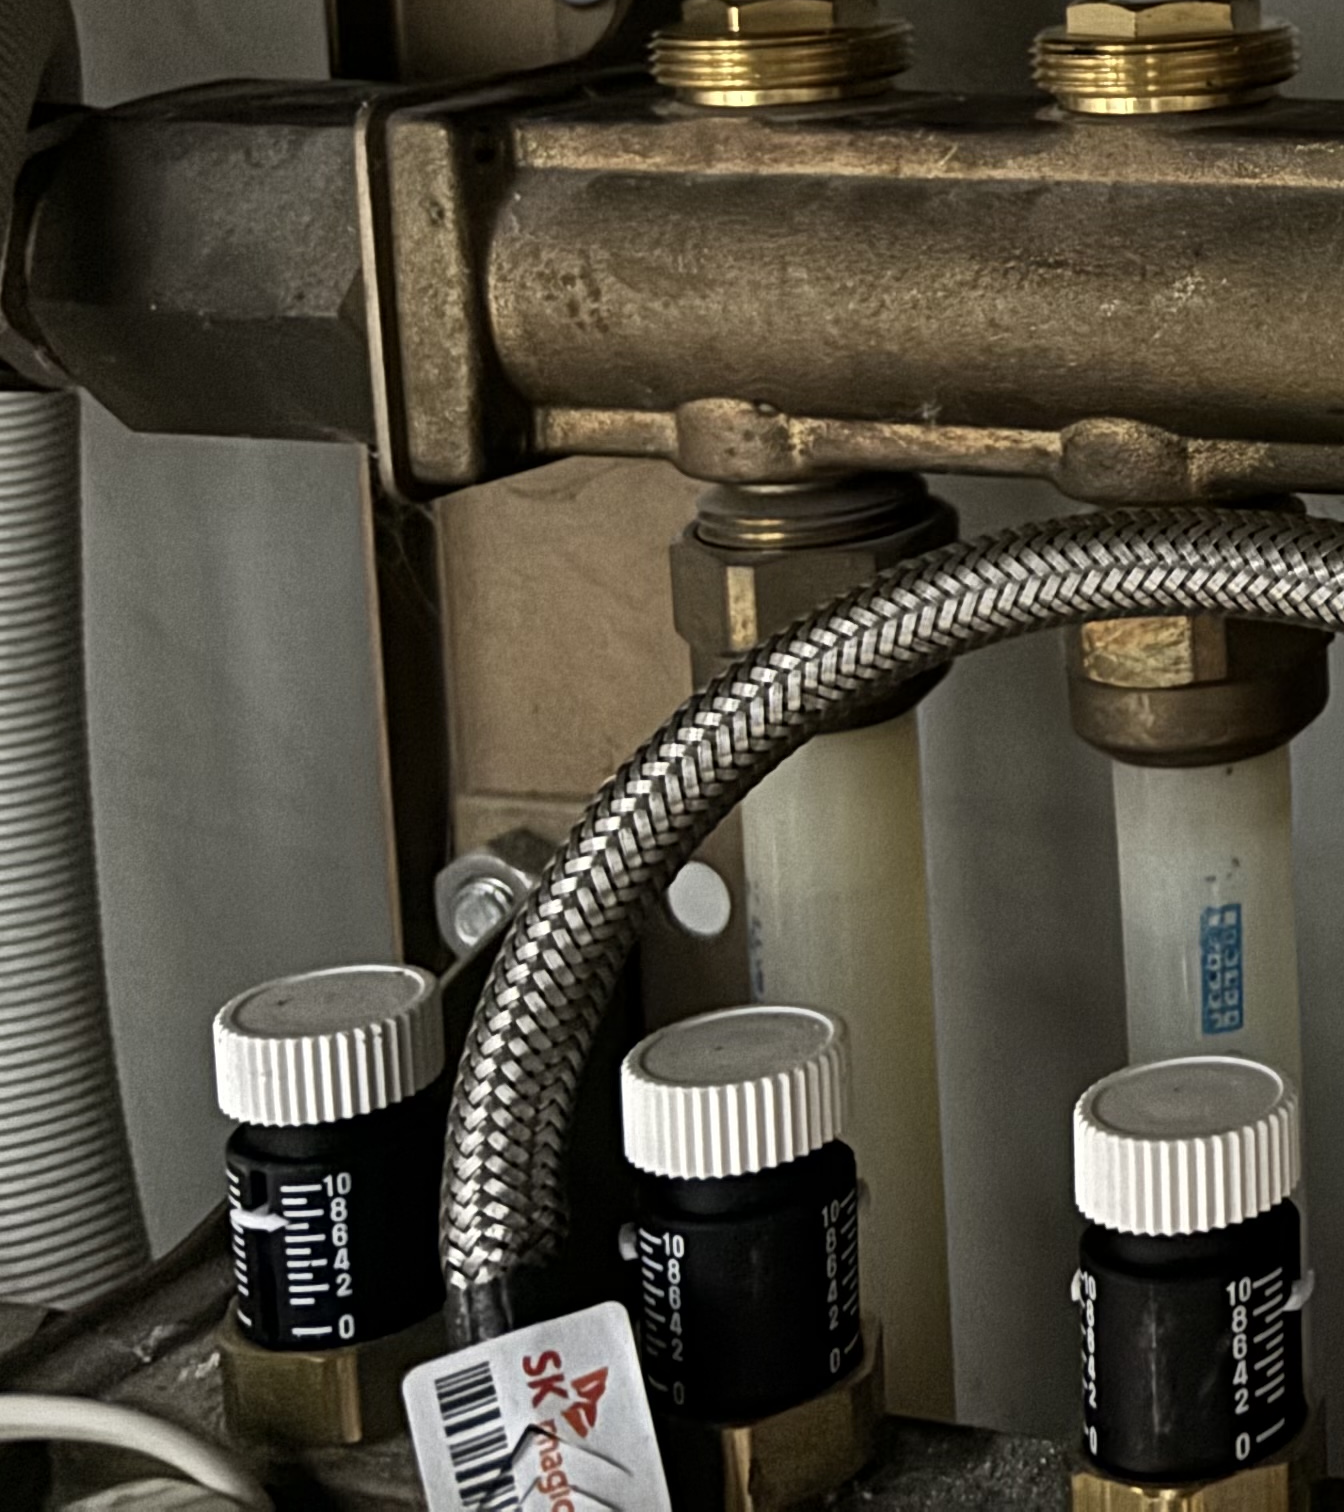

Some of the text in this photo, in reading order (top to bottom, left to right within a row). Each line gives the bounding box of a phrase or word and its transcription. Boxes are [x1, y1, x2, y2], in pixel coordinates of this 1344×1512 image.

[322, 1172, 352, 1197] 10
[330, 1197, 348, 1222] 8
[821, 1199, 840, 1228] 10
[332, 1223, 349, 1247] 6
[662, 1232, 685, 1259] 10
[825, 1227, 837, 1253] 8
[333, 1247, 350, 1270] 4
[826, 1254, 837, 1279] 6
[667, 1259, 681, 1284] 8
[336, 1273, 353, 1297] 2
[669, 1285, 681, 1310] 6
[827, 1280, 838, 1304] 4
[1226, 1276, 1253, 1306] 10
[338, 1314, 355, 1339] 0
[669, 1311, 682, 1336] 4
[828, 1305, 839, 1331] 2
[1231, 1305, 1248, 1333] 8
[671, 1337, 684, 1362] 2
[1232, 1334, 1248, 1360] 6
[829, 1348, 840, 1374] 0
[1233, 1361, 1248, 1386] 4
[522, 1350, 569, 1409] SK
[673, 1381, 685, 1405] 0
[1234, 1388, 1250, 1415] 2
[1235, 1431, 1250, 1461] 0
